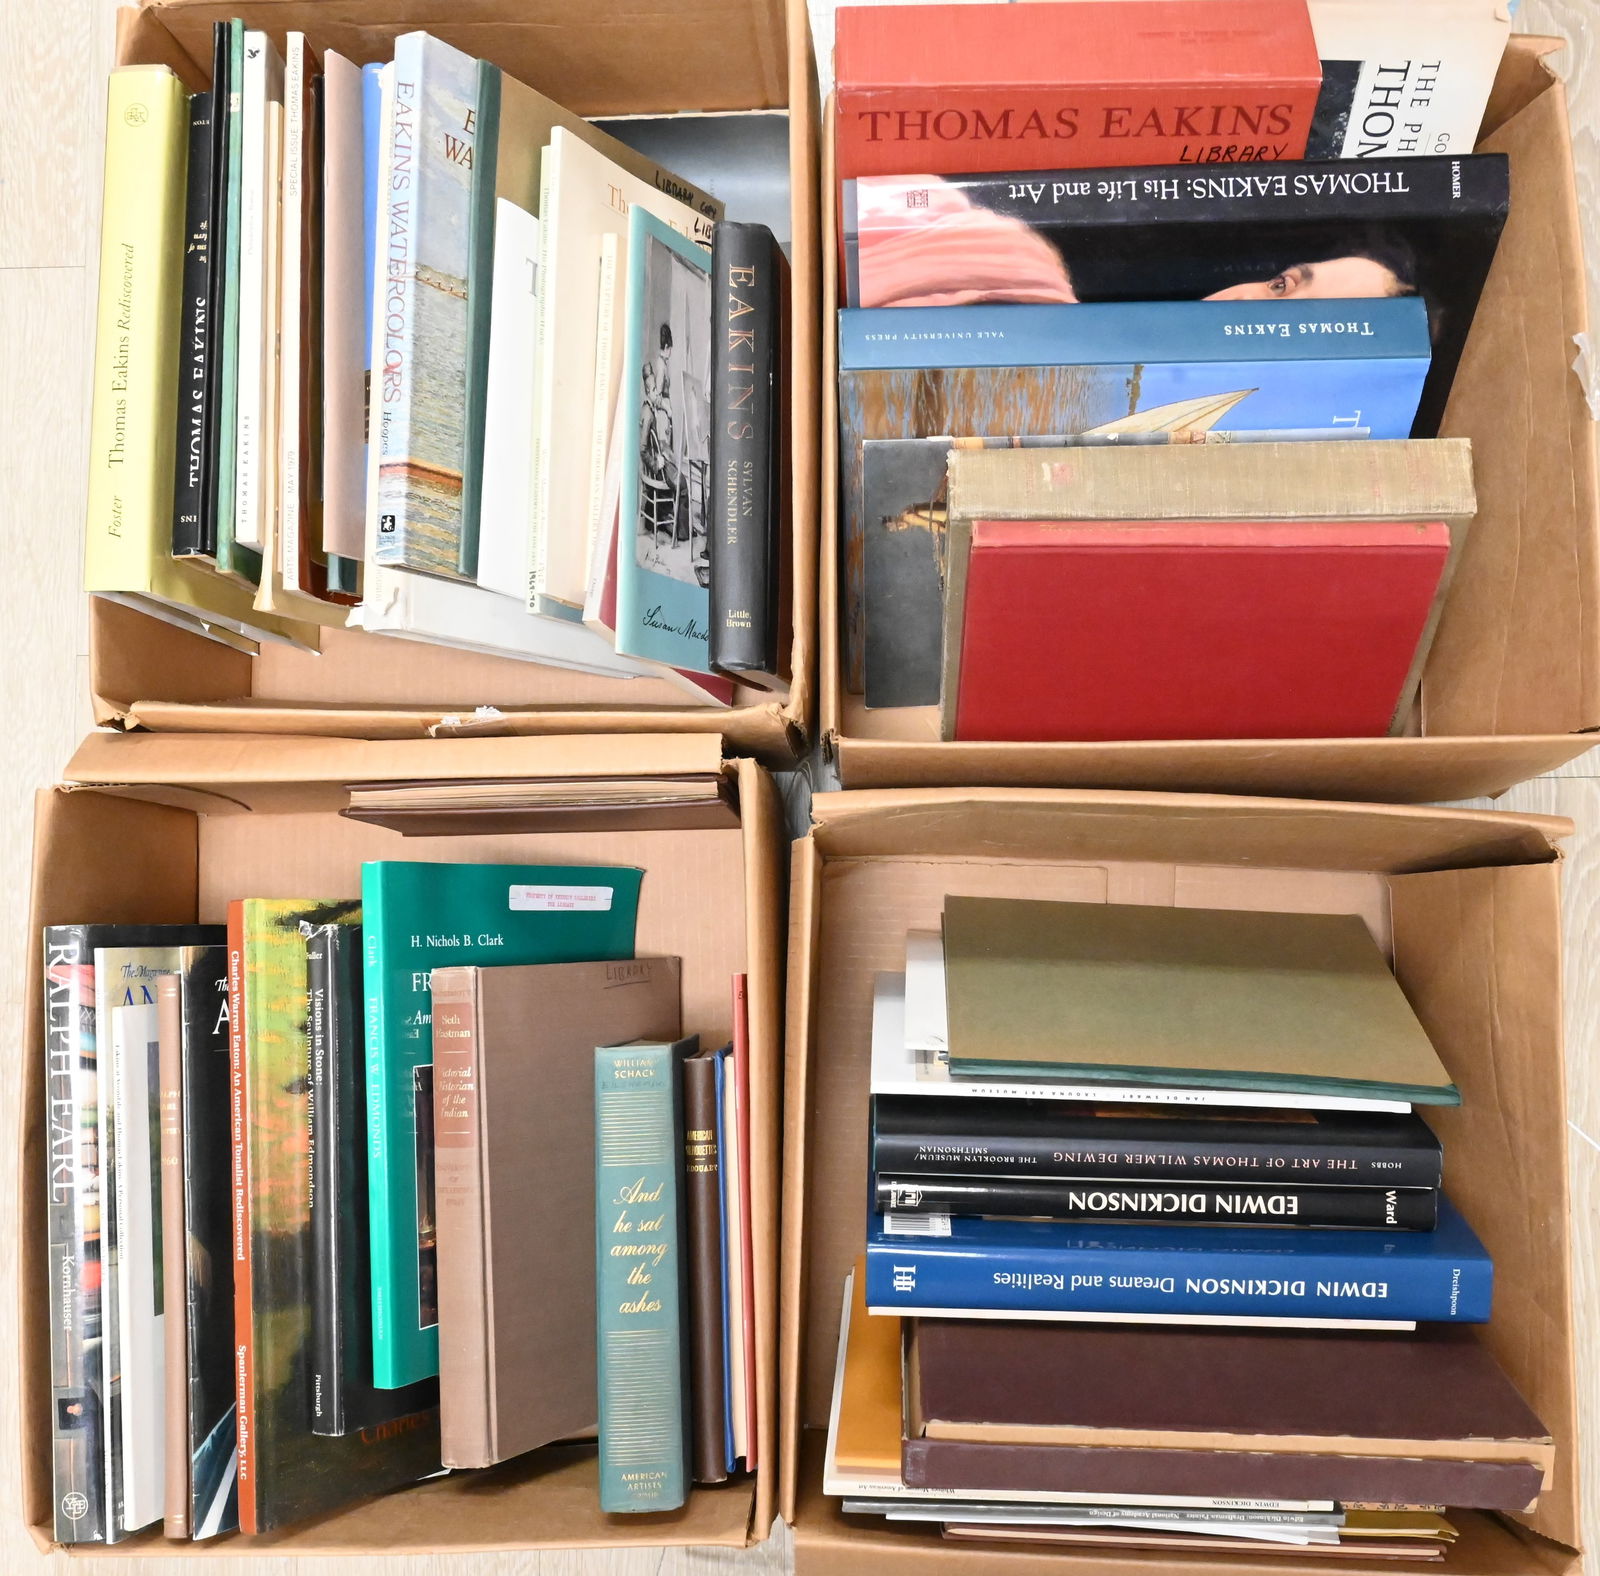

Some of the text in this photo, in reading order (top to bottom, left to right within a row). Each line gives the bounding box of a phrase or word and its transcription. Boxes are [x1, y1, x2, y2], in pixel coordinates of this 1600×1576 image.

[1410, 60, 1442, 108] THE
[288, 47, 300, 197] SPECIAL ISSUE THOMAS EAKINS
[858, 103, 1294, 142] THOMAS EAKINS
[392, 81, 415, 192] EAKINS
[1179, 142, 1288, 164] LIBRARY
[655, 169, 694, 205] LIBRARY
[1007, 170, 1410, 204] THOMAS EAKINS: His Life and Art
[1451, 160, 1461, 198] HOMER
[383, 199, 409, 404] WATERCOLORS
[864, 330, 1005, 342] YALE UNIVERSITY PRESS
[727, 263, 756, 441] EAKINS
[108, 243, 135, 539] Foster Thomas Eakins Rediscovered
[381, 411, 393, 456] Hoopes
[240, 415, 251, 524] THOMAS EAKINS
[742, 460, 753, 517] SYLVAN
[287, 450, 296, 581] ARTS MAGAZINE MAY 1979
[727, 460, 738, 545] SCHENDLER
[642, 605, 677, 633] Susan
[726, 619, 752, 628] Brown
[728, 609, 752, 620] Little,
[367, 935, 377, 968] Clark
[411, 932, 504, 949] H. Nichols B. Clark
[605, 963, 653, 982] LIBRARY
[368, 997, 379, 1059] FRANCIS
[441, 1014, 460, 1025] Seth
[314, 988, 325, 1086] Visions in Stone:
[306, 1073, 315, 1086] of
[614, 1070, 656, 1079] SCHACK
[231, 950, 246, 1261] Charles Warren Eaton: An American Tonalist Rediscovered
[307, 1088, 315, 1136] William
[441, 1108, 469, 1118] Indian
[442, 1095, 466, 1106] of the
[371, 1084, 382, 1159] EDMONDS
[48, 942, 81, 1331] RALPH EARL Kornhauser
[918, 1145, 988, 1154] SMITHSONIAN
[914, 1152, 1037, 1164] THE BROOKLYN MUSEUM/
[1053, 1151, 1358, 1170] THE ART OF THOMAS WILMER DEWING
[1370, 1161, 1402, 1169] HOBBS
[612, 1176, 664, 1205] And
[1068, 1189, 1398, 1225] Ward EDWIN DICKINSON
[612, 1210, 663, 1233] he sat
[610, 1240, 668, 1266] among
[627, 1262, 652, 1285] the
[993, 1271, 1389, 1299] EDWIN DICKINSON Dreams and Realities
[619, 1290, 662, 1314] ashes
[1449, 1267, 1461, 1316] Dreishpoon
[237, 1344, 248, 1414] Spanierman
[238, 1415, 249, 1458] Gallery,
[621, 1471, 668, 1481] AMERICAN
[627, 1481, 662, 1491] ARTISTS
[868, 1484, 897, 1492] American
[1088, 1509, 1111, 1518] Design
[1120, 1509, 1151, 1519] Academy
[1151, 1511, 1180, 1520] National
[1186, 1512, 1209, 1521] Painter
[1211, 1499, 1252, 1507] DICKINSON
[1210, 1513, 1245, 1522] Draftsman
[1282, 1515, 1304, 1523] Edwin
